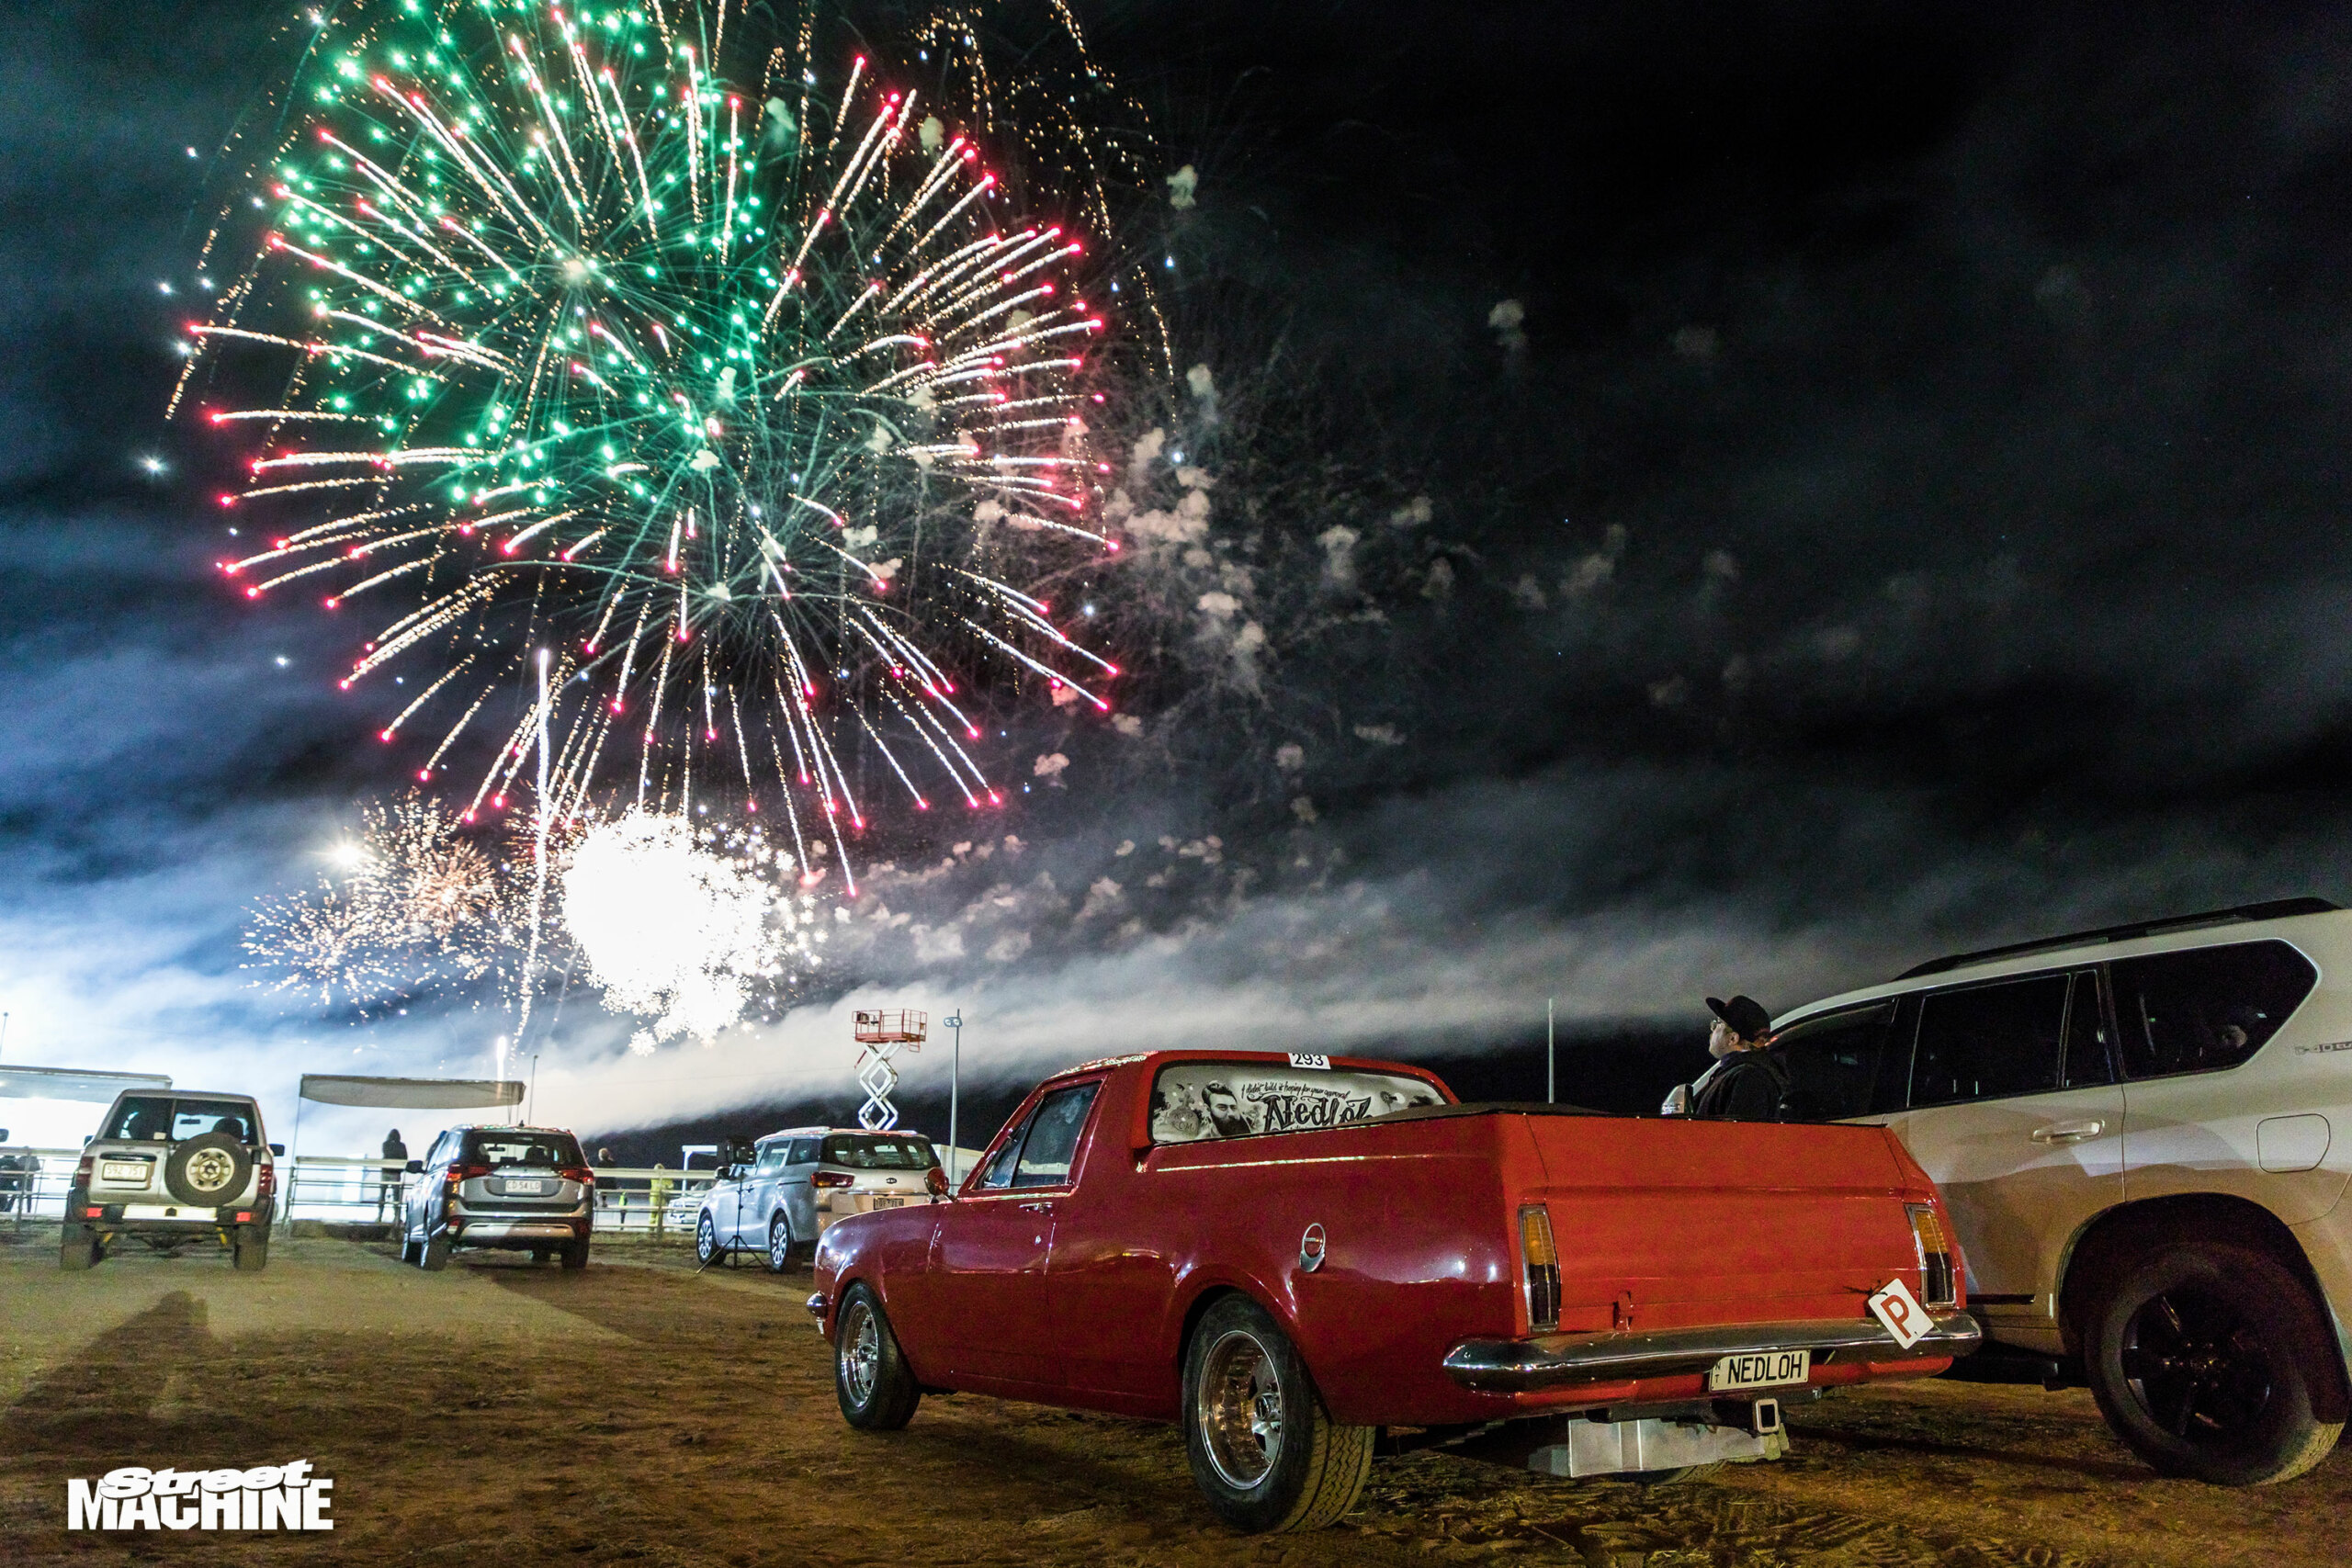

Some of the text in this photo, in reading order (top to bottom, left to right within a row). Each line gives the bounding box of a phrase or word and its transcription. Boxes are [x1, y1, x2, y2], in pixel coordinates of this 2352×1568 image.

[1292, 1052, 1324, 1066] 293
[1283, 1081, 1302, 1096] hoping
[1301, 1084, 1311, 1096] for
[1324, 1089, 1351, 1100] approval
[1880, 1294, 1912, 1340] P
[1727, 1353, 1803, 1384] NEDLOH
